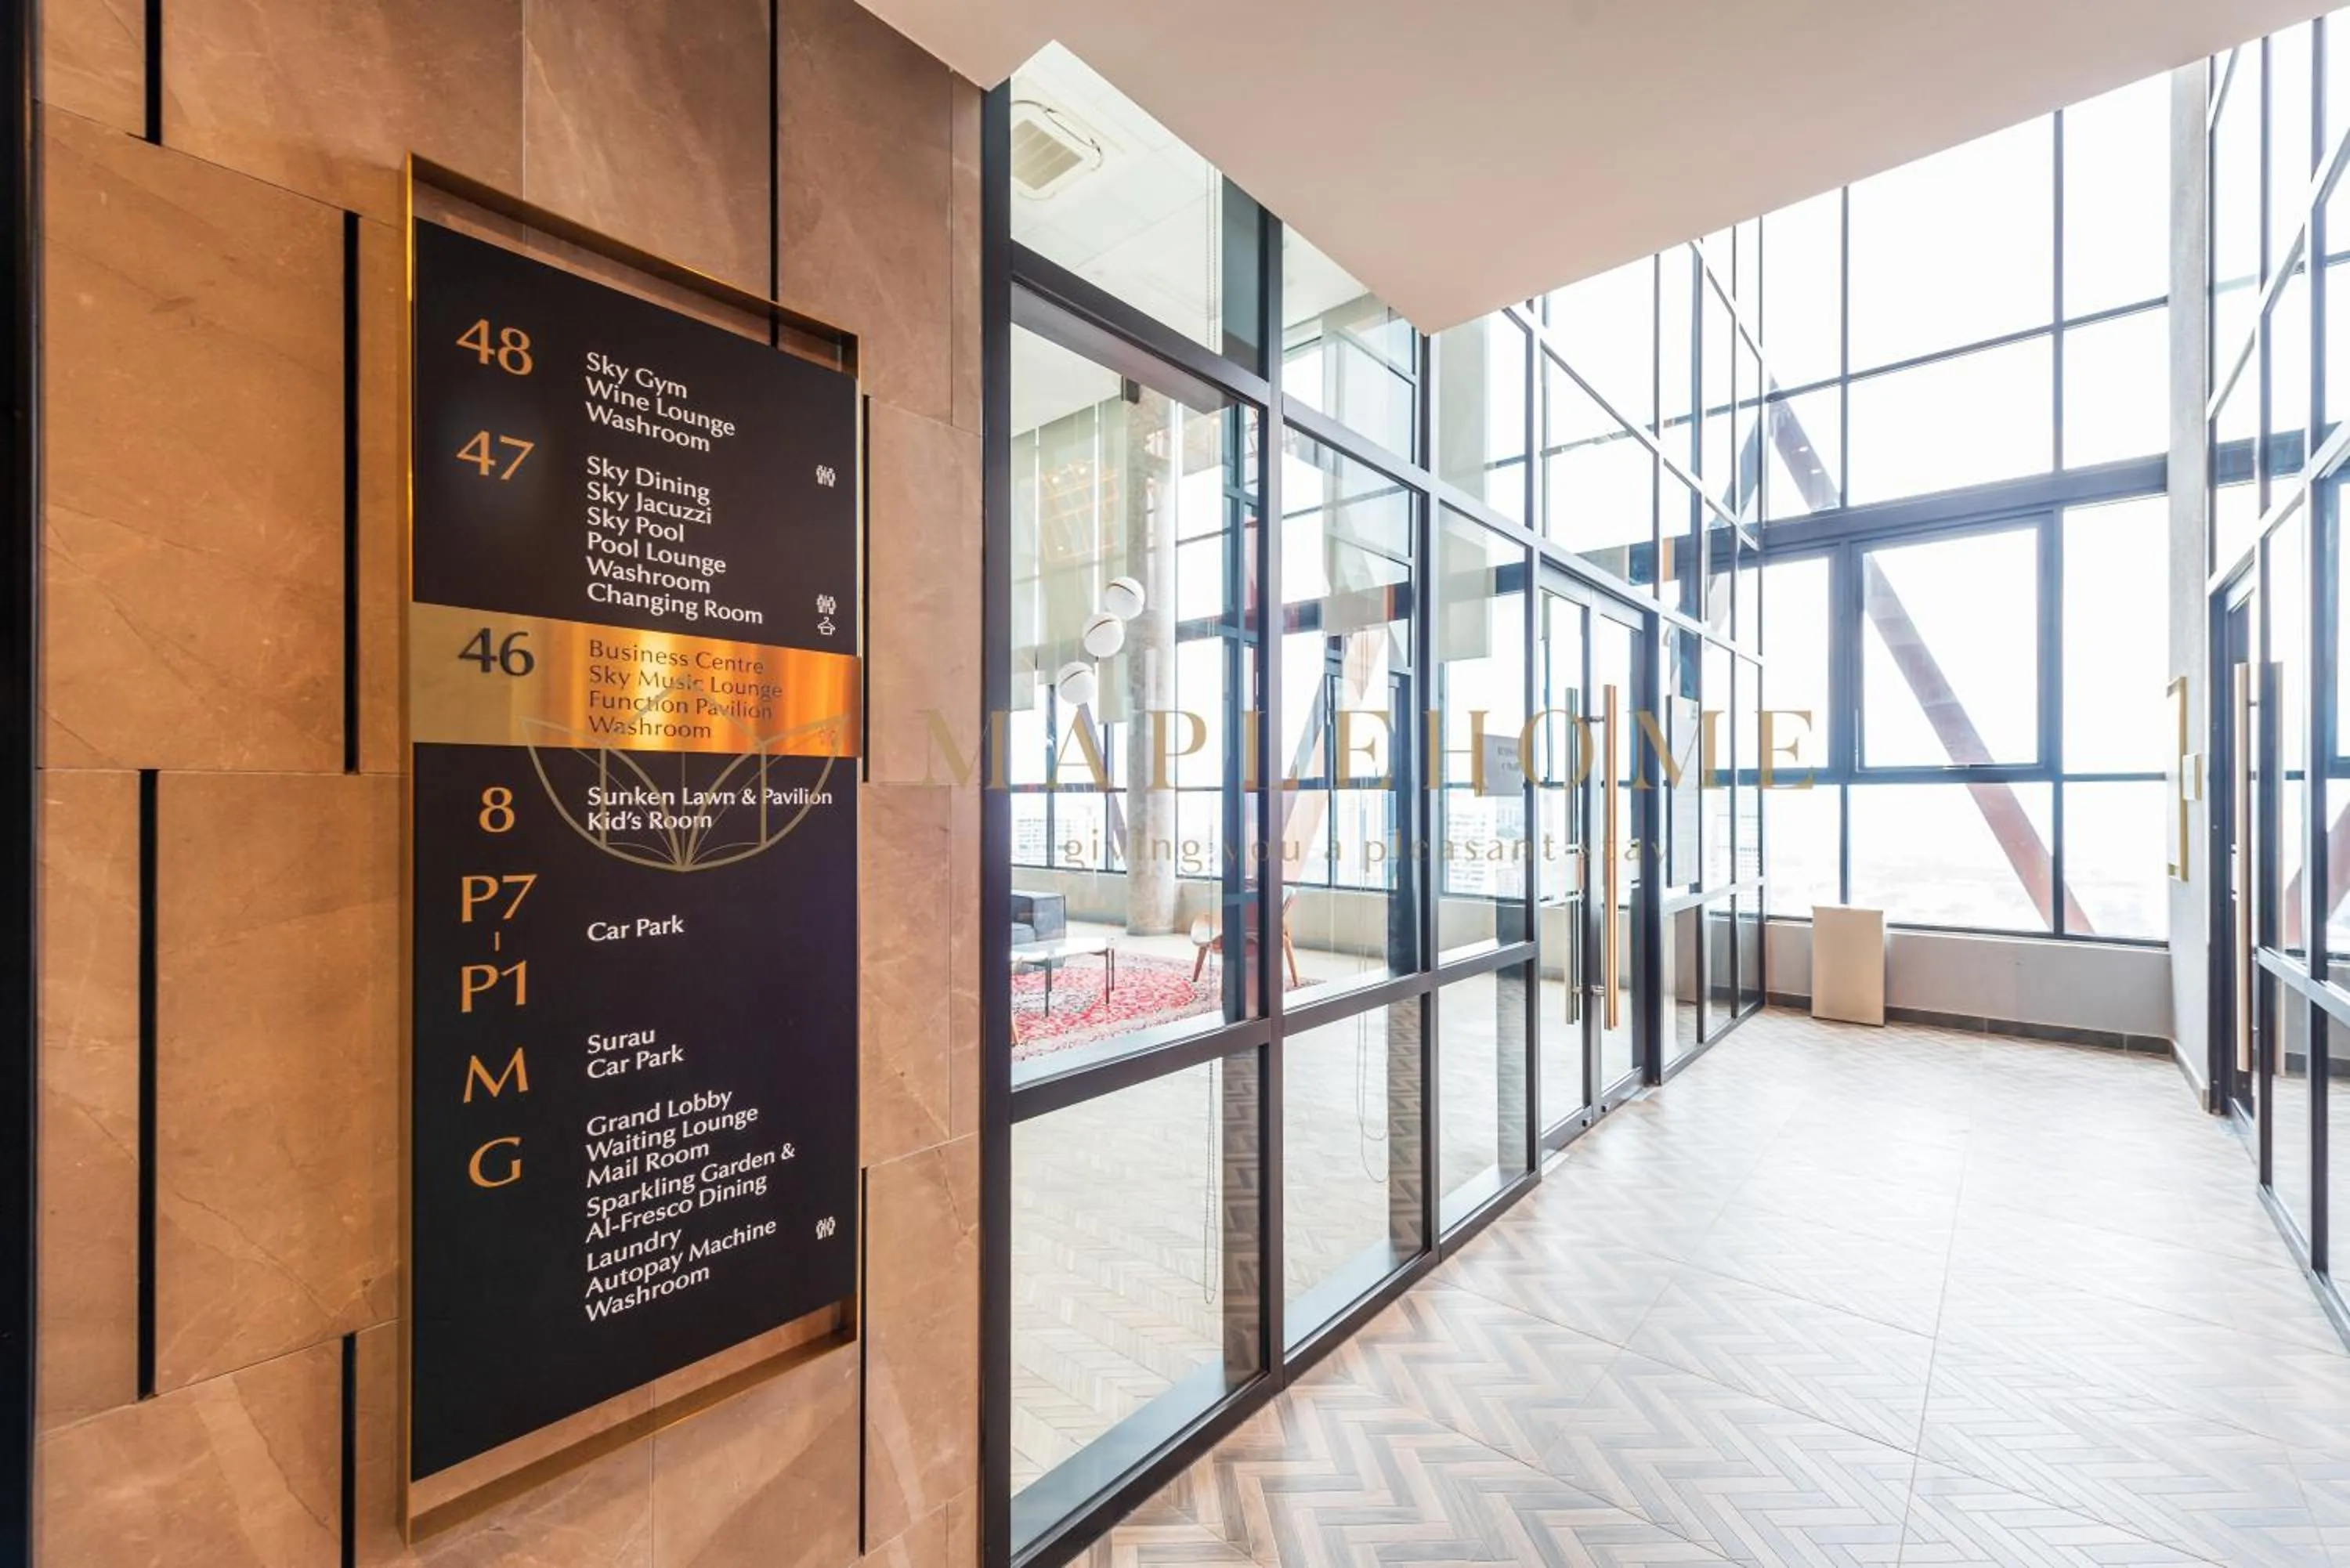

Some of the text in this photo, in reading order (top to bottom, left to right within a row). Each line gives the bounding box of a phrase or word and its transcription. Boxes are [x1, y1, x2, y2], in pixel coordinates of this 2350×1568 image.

[456, 319, 533, 375] 48
[587, 352, 687, 399] Sky Gym
[586, 376, 735, 438] Wine Lounge
[586, 401, 710, 452] Washroom
[456, 430, 534, 480] 47
[587, 456, 710, 505] Sky Dining
[587, 482, 711, 525] Sky Jacuzzi
[587, 507, 684, 542] Sky Pool
[586, 556, 710, 594] Washroom
[588, 532, 726, 574] Pool Lounge
[587, 583, 762, 624] Changing Room
[458, 628, 534, 677] 46
[589, 640, 764, 674] Business Centre
[589, 666, 782, 700] Sky Music Lounge
[589, 690, 772, 720] Function Pavilion
[589, 716, 711, 739] Washroom
[479, 787, 515, 833] 8
[588, 787, 832, 806] Sunken Lawn & Pavilion
[588, 811, 711, 830] Kid's Room
[461, 873, 537, 923] P7
[588, 916, 684, 941] Car Park
[461, 961, 526, 1013] P1
[588, 1029, 655, 1053] Surau
[588, 1045, 684, 1078] Car Park
[463, 1047, 529, 1104] M
[586, 1107, 757, 1162] Waiting Lounge
[587, 1090, 732, 1136] Grand Lobby
[468, 1136, 522, 1188] G
[587, 1143, 709, 1188] Mail Room
[587, 1143, 795, 1218] Sparkling Garden &
[586, 1175, 766, 1243] Al-Fresco Dining
[585, 1218, 776, 1298] Autopay Machine
[587, 1227, 682, 1272] Laundry
[585, 1265, 709, 1322] Washroom
